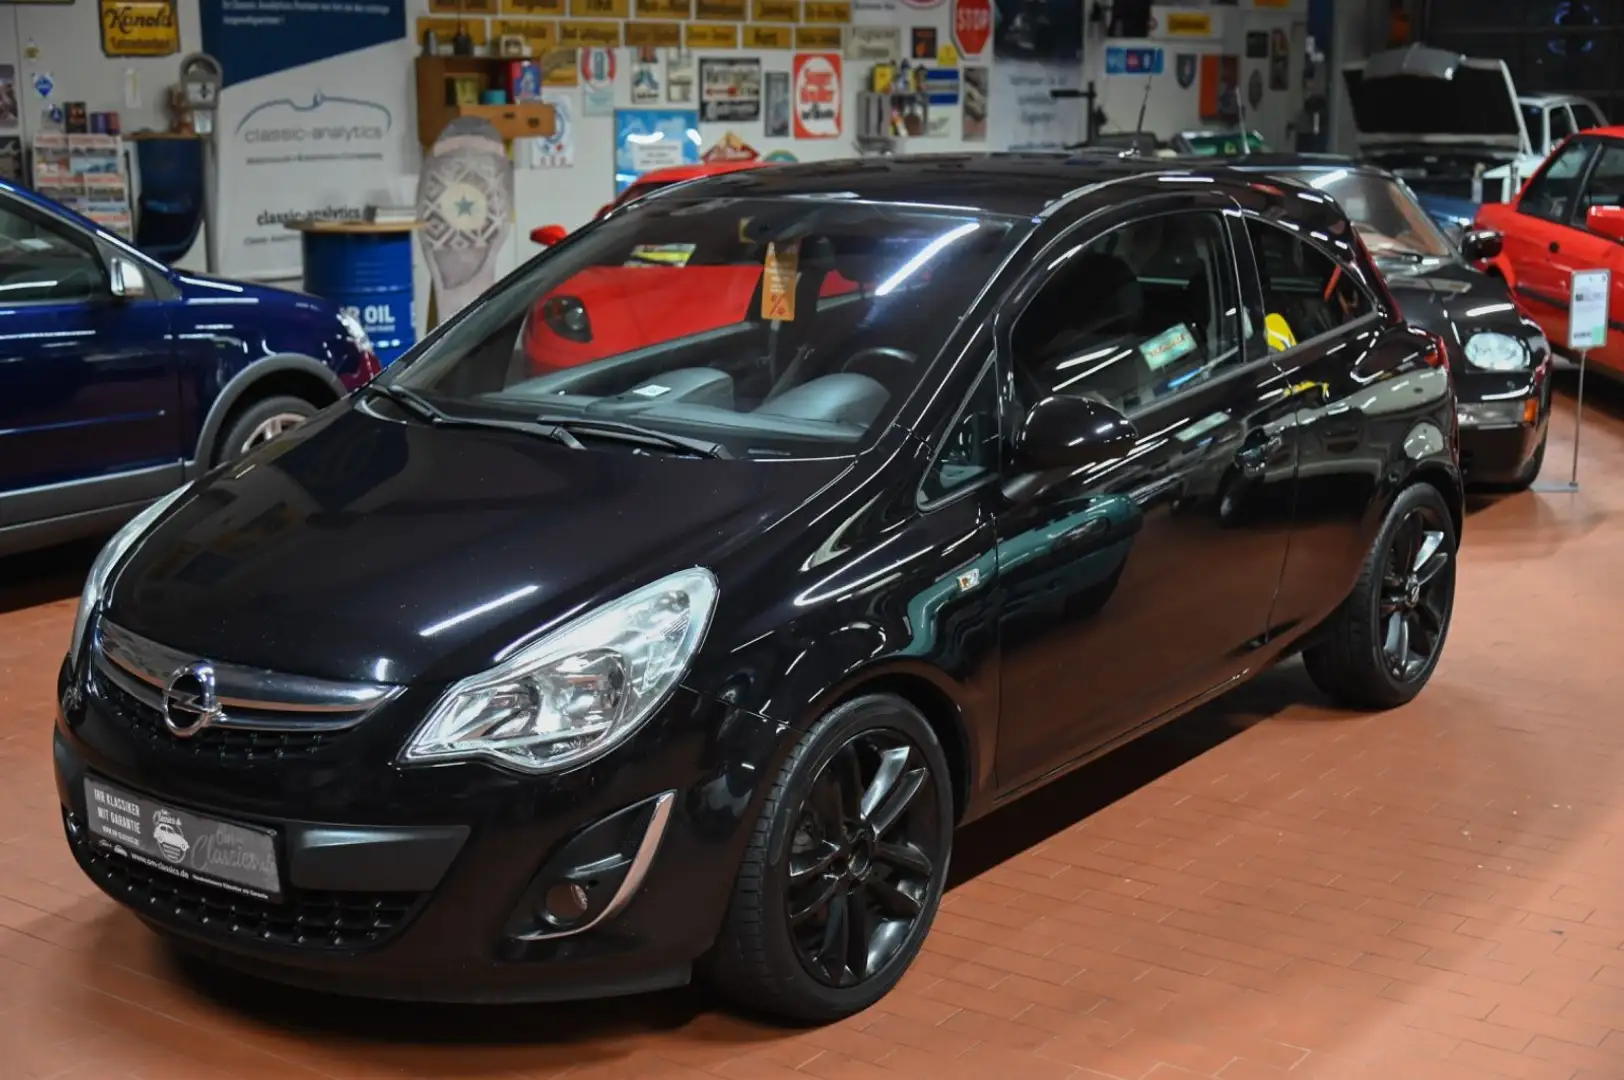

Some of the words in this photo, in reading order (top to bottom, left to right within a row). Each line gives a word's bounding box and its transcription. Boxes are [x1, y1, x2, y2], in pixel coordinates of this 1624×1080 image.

[104, 5, 174, 34] Kanold
[959, 7, 990, 32] STOP
[364, 304, 396, 324] OIL
[106, 793, 140, 818] KLASSIKER
[97, 806, 109, 821] MIT
[110, 811, 141, 834] GARANTIE
